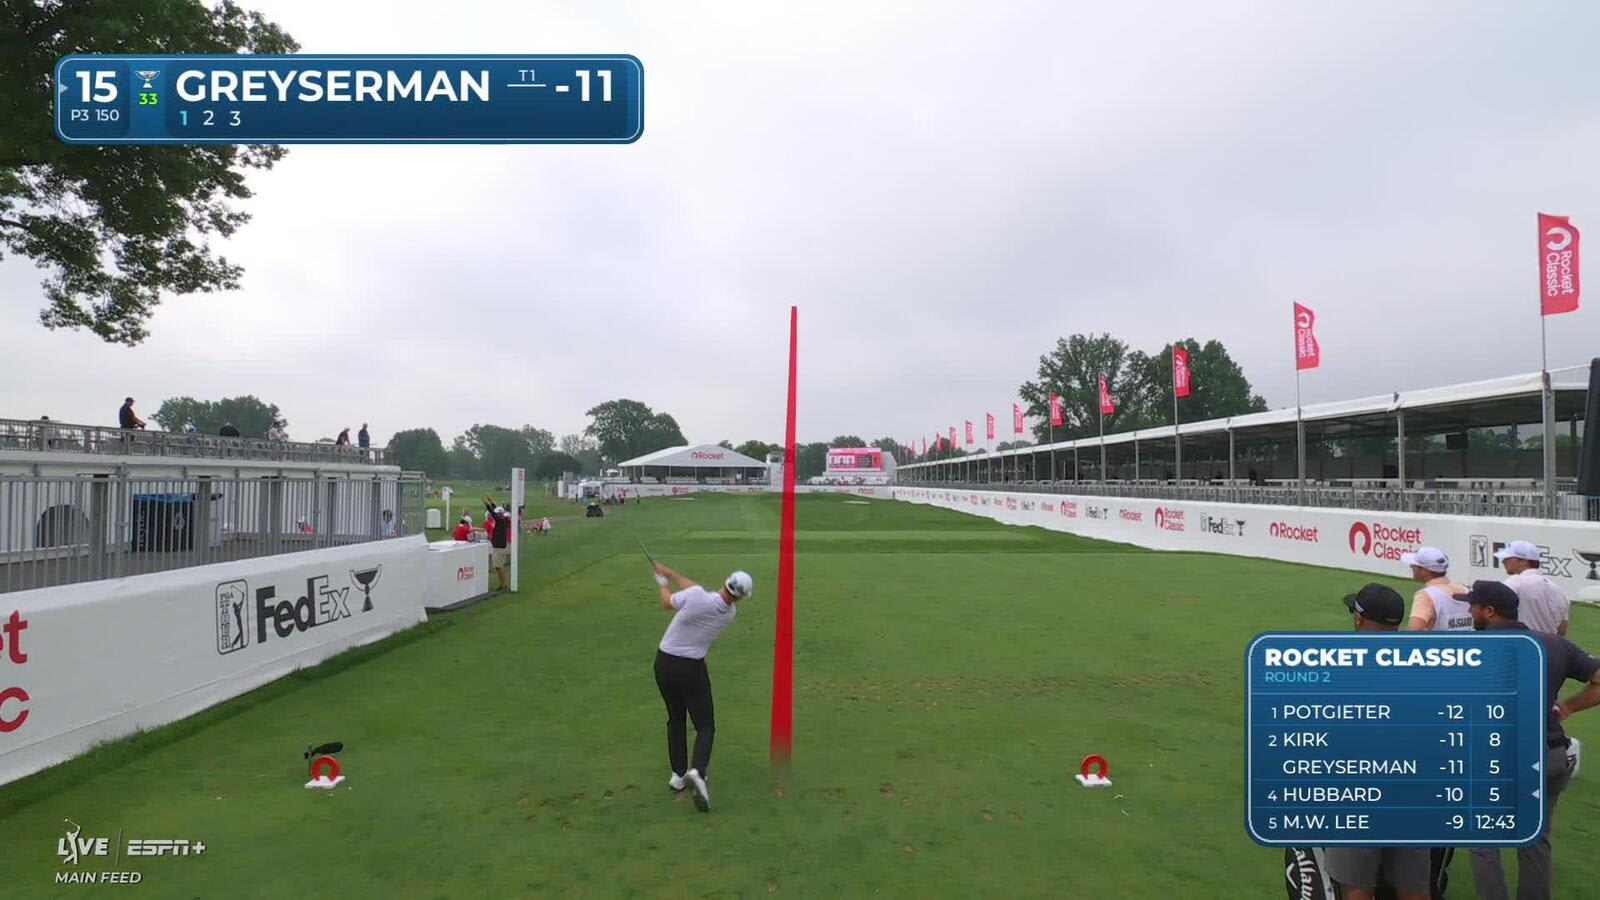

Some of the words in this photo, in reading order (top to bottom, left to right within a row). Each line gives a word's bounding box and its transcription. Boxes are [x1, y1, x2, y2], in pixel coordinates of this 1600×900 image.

[1546, 252, 1560, 297] Classic
[1561, 250, 1575, 295] Rocket
[1280, 522, 1318, 543] Rocket
[1373, 523, 1421, 544] Rocket
[1373, 541, 1418, 561] Clas
[1493, 542, 1572, 578] FEx
[256, 575, 351, 644] FedEx
